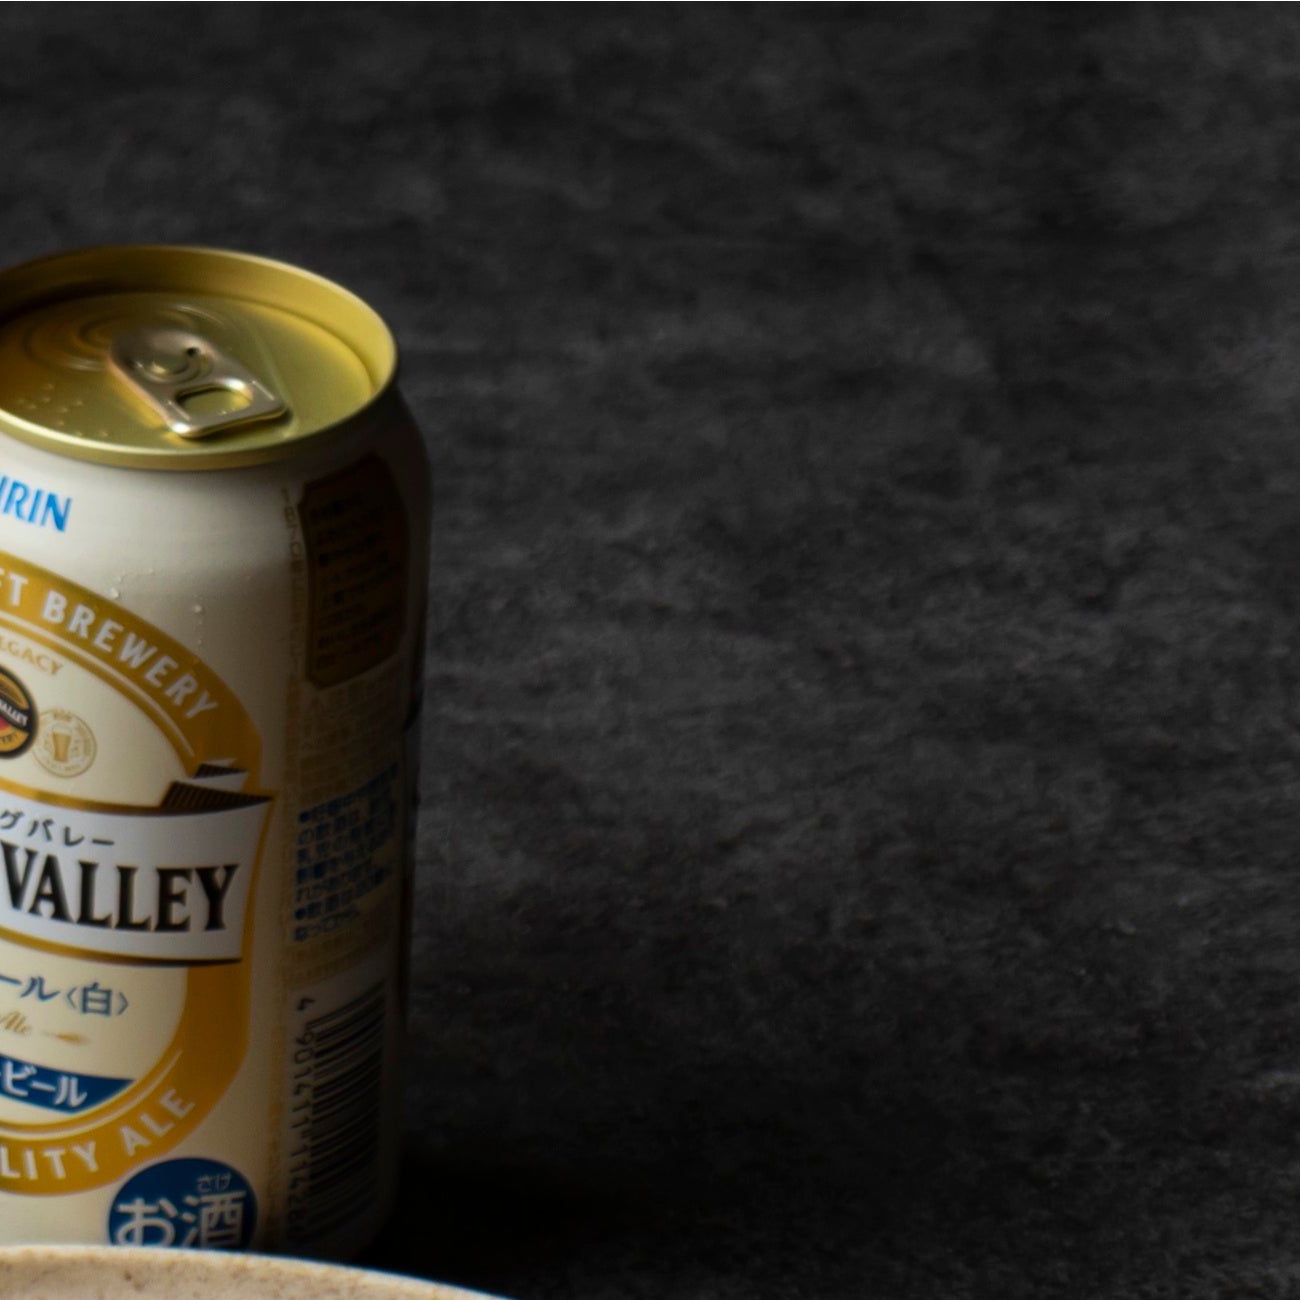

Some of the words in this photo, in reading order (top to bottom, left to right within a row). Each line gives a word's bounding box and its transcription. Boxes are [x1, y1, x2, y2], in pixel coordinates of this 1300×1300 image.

[41, 589, 218, 720] BREWERY
[0, 838, 241, 933] VALLEY
[118, 1087, 196, 1156] ALE
[116, 1190, 248, 1248] お酒
